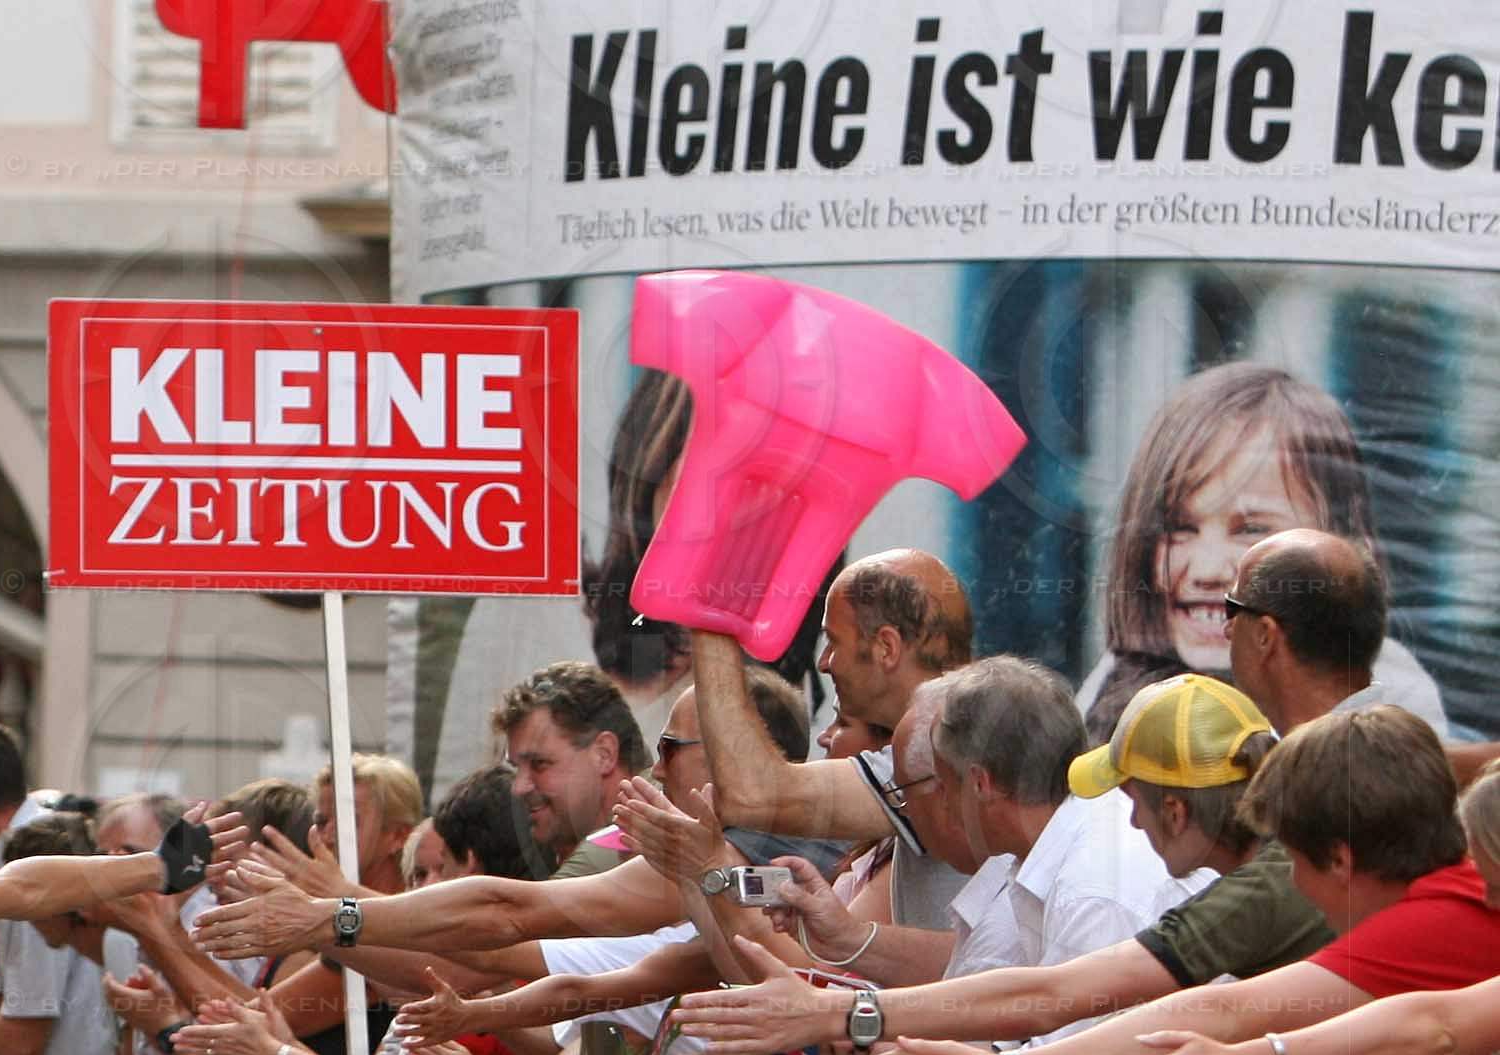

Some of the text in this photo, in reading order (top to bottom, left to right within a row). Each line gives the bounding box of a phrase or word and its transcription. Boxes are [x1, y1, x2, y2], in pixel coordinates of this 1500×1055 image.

[563, 10, 1500, 184] Kleine ist wie ke
[556, 207, 638, 249] Täglich
[641, 207, 709, 238] lesen,
[706, 212, 765, 234] was
[769, 202, 811, 232] die
[819, 200, 880, 230] Welt
[889, 197, 989, 235] bewegt
[1021, 195, 1049, 225] in
[1056, 193, 1108, 225] der
[1114, 192, 1239, 233] größten
[108, 346, 523, 451] KLEINE
[107, 475, 527, 552] ZEITUNG
